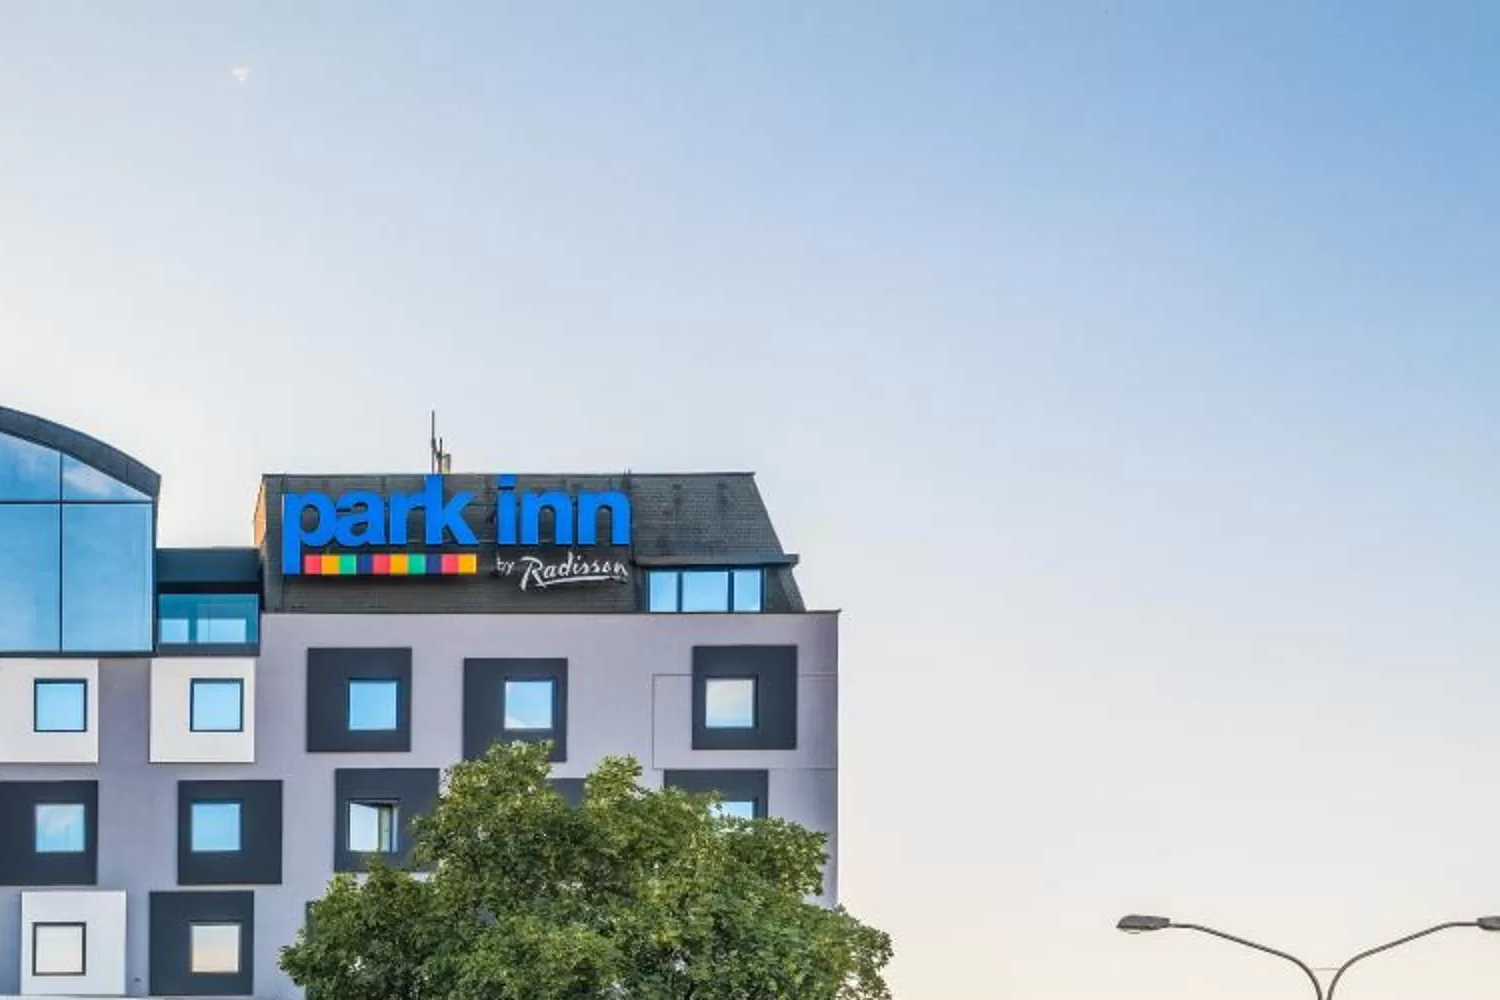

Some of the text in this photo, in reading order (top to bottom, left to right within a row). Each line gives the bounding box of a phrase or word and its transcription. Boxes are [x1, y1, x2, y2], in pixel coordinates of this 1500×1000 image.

[281, 474, 632, 575] park inn
[495, 551, 629, 592] by Radisson
